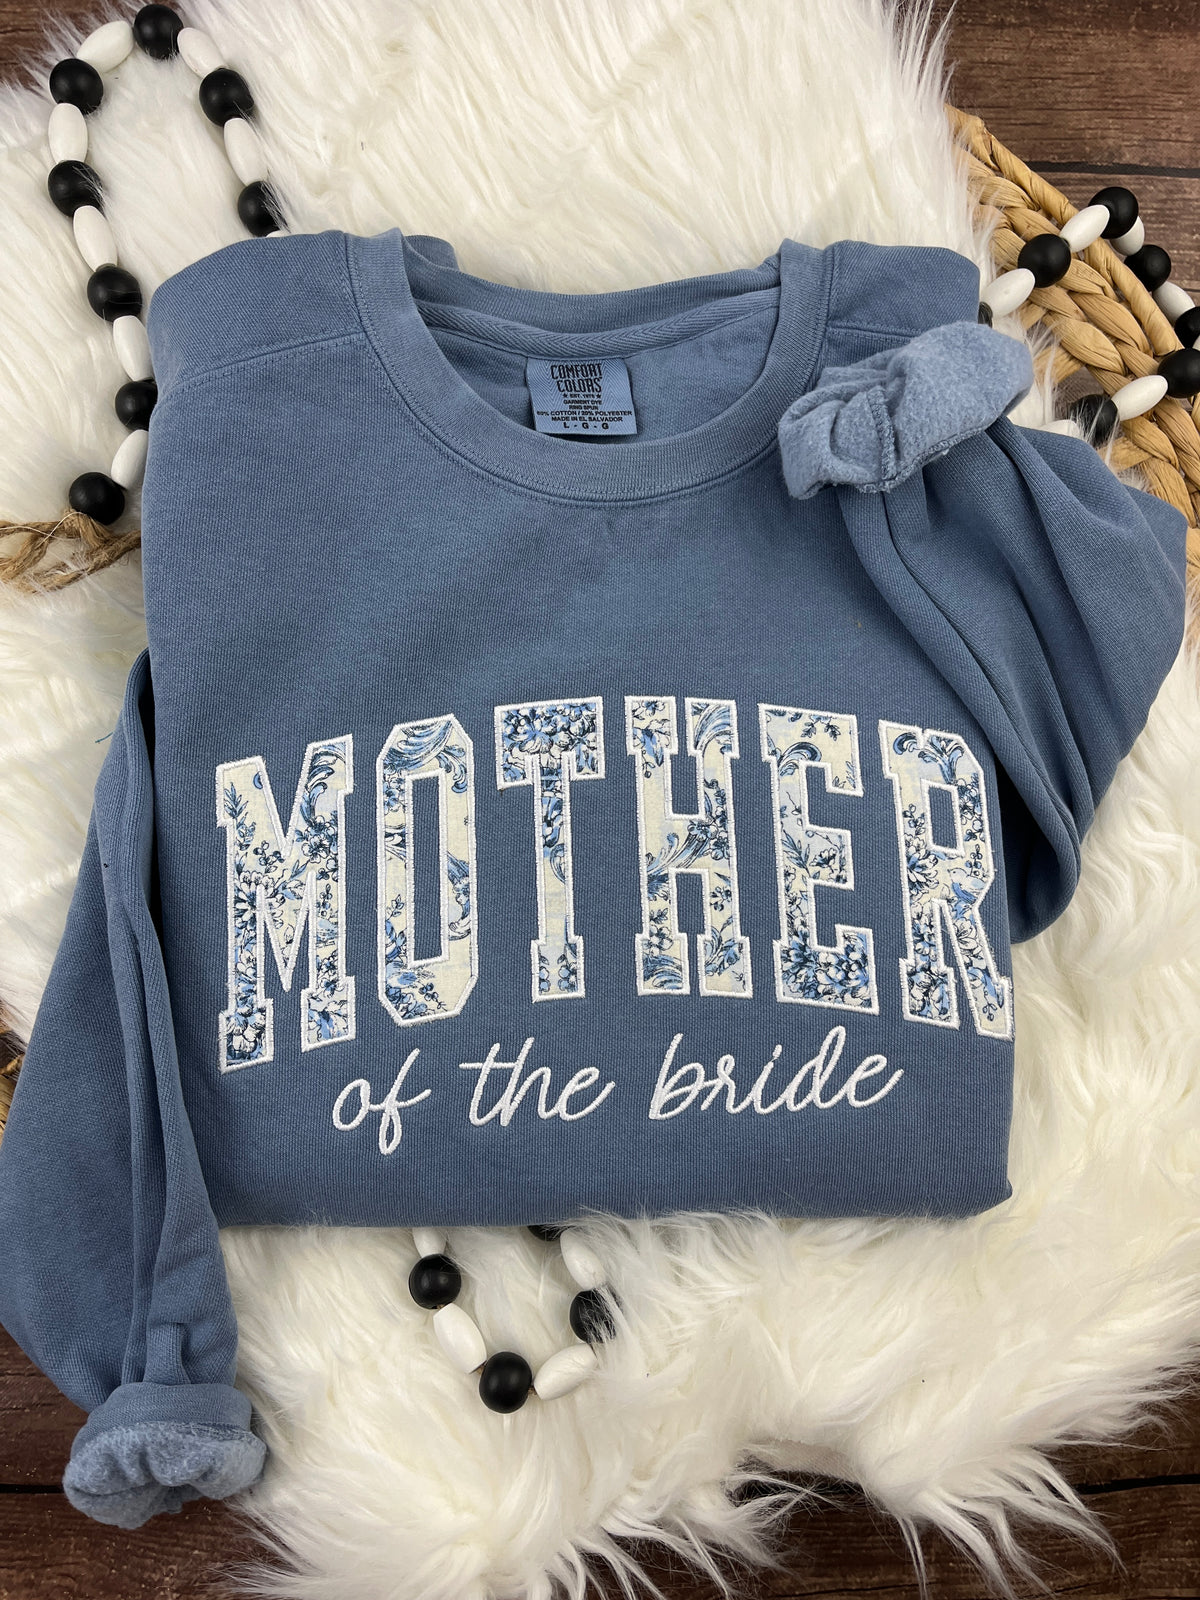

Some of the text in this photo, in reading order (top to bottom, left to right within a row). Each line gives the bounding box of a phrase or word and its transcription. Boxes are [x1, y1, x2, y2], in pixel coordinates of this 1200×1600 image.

[550, 363, 603, 380] COMFORT
[556, 378, 602, 393] COLORS
[582, 422, 590, 430] G
[602, 422, 610, 430] G
[214, 694, 1014, 1074] MOTHER
[331, 1025, 904, 1156] of the bride
